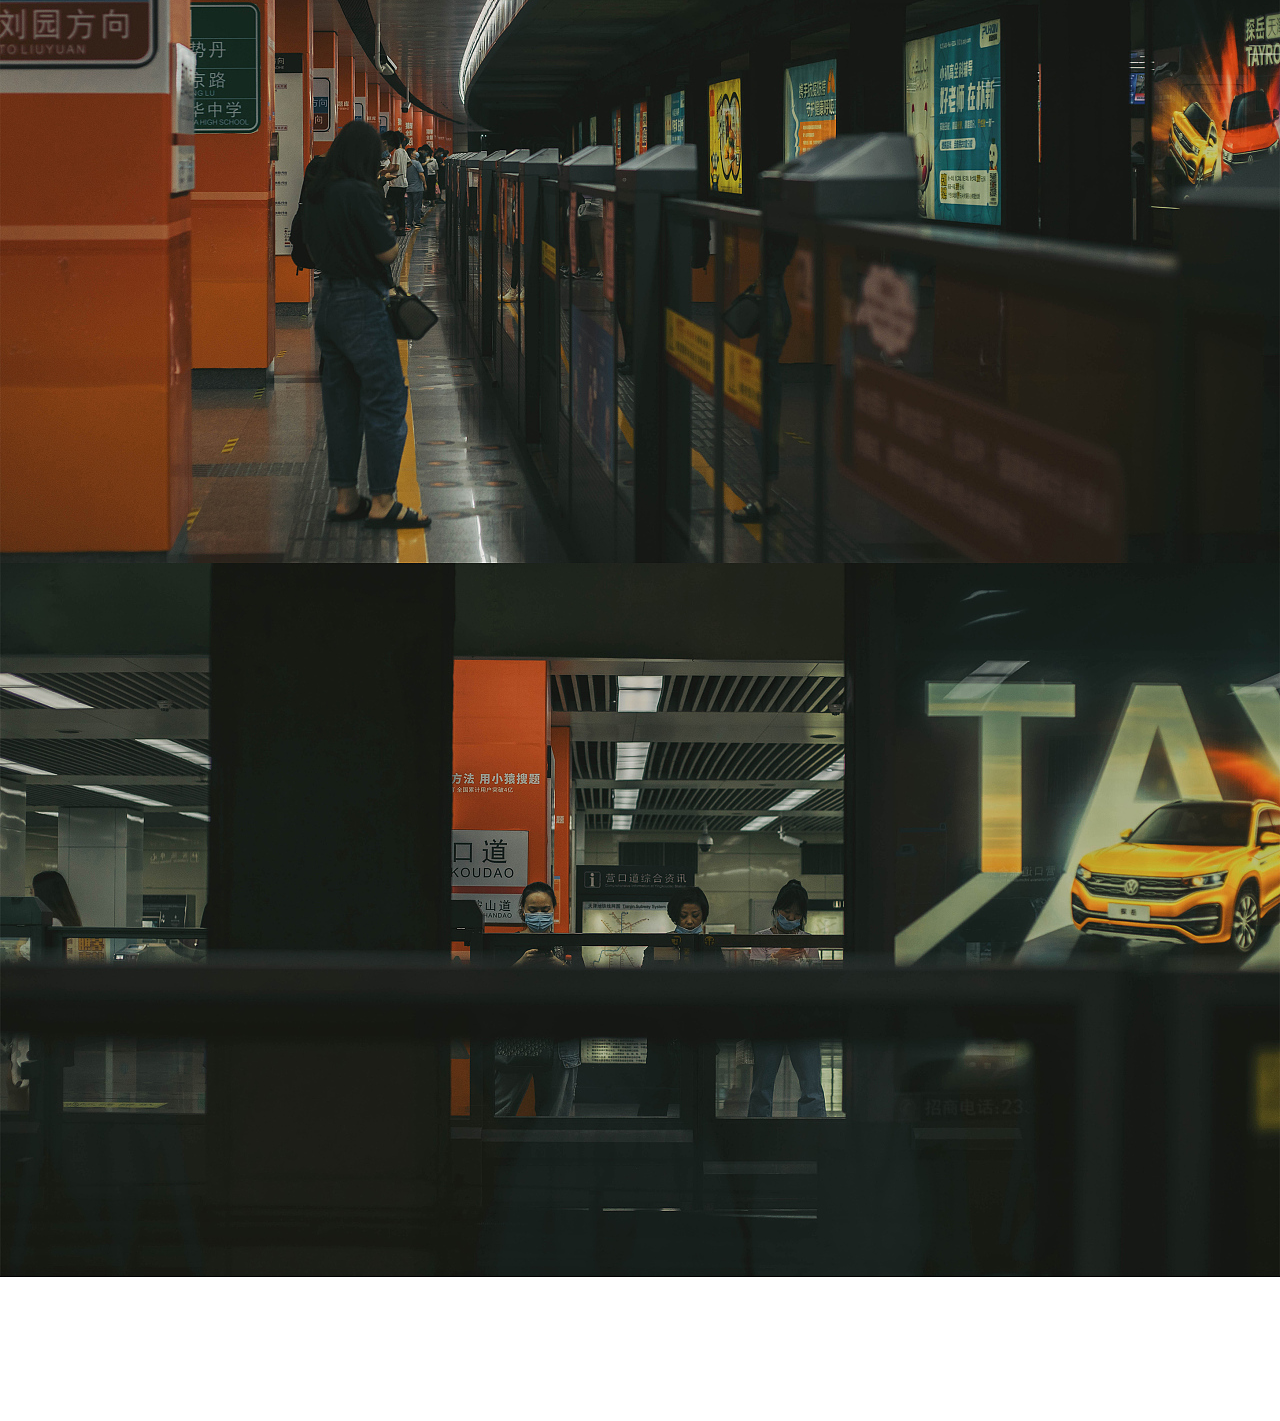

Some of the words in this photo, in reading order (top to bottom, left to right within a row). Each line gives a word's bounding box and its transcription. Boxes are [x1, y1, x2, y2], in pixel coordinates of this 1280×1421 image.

[0, 9, 129, 40] 刘园方向
[1245, 16, 1266, 42] 探岳
[21, 44, 86, 55] LIUYUAN
[191, 41, 226, 59] 势丹
[194, 72, 226, 89] 京路
[940, 84, 965, 114] 好老师
[194, 102, 242, 118] 华中学
[452, 773, 475, 785] 方法
[479, 773, 541, 785] 用小猿搜题
[453, 839, 508, 864] 口道
[451, 867, 514, 879] KOUDAO
[605, 873, 687, 884] 营口道综合资讯
